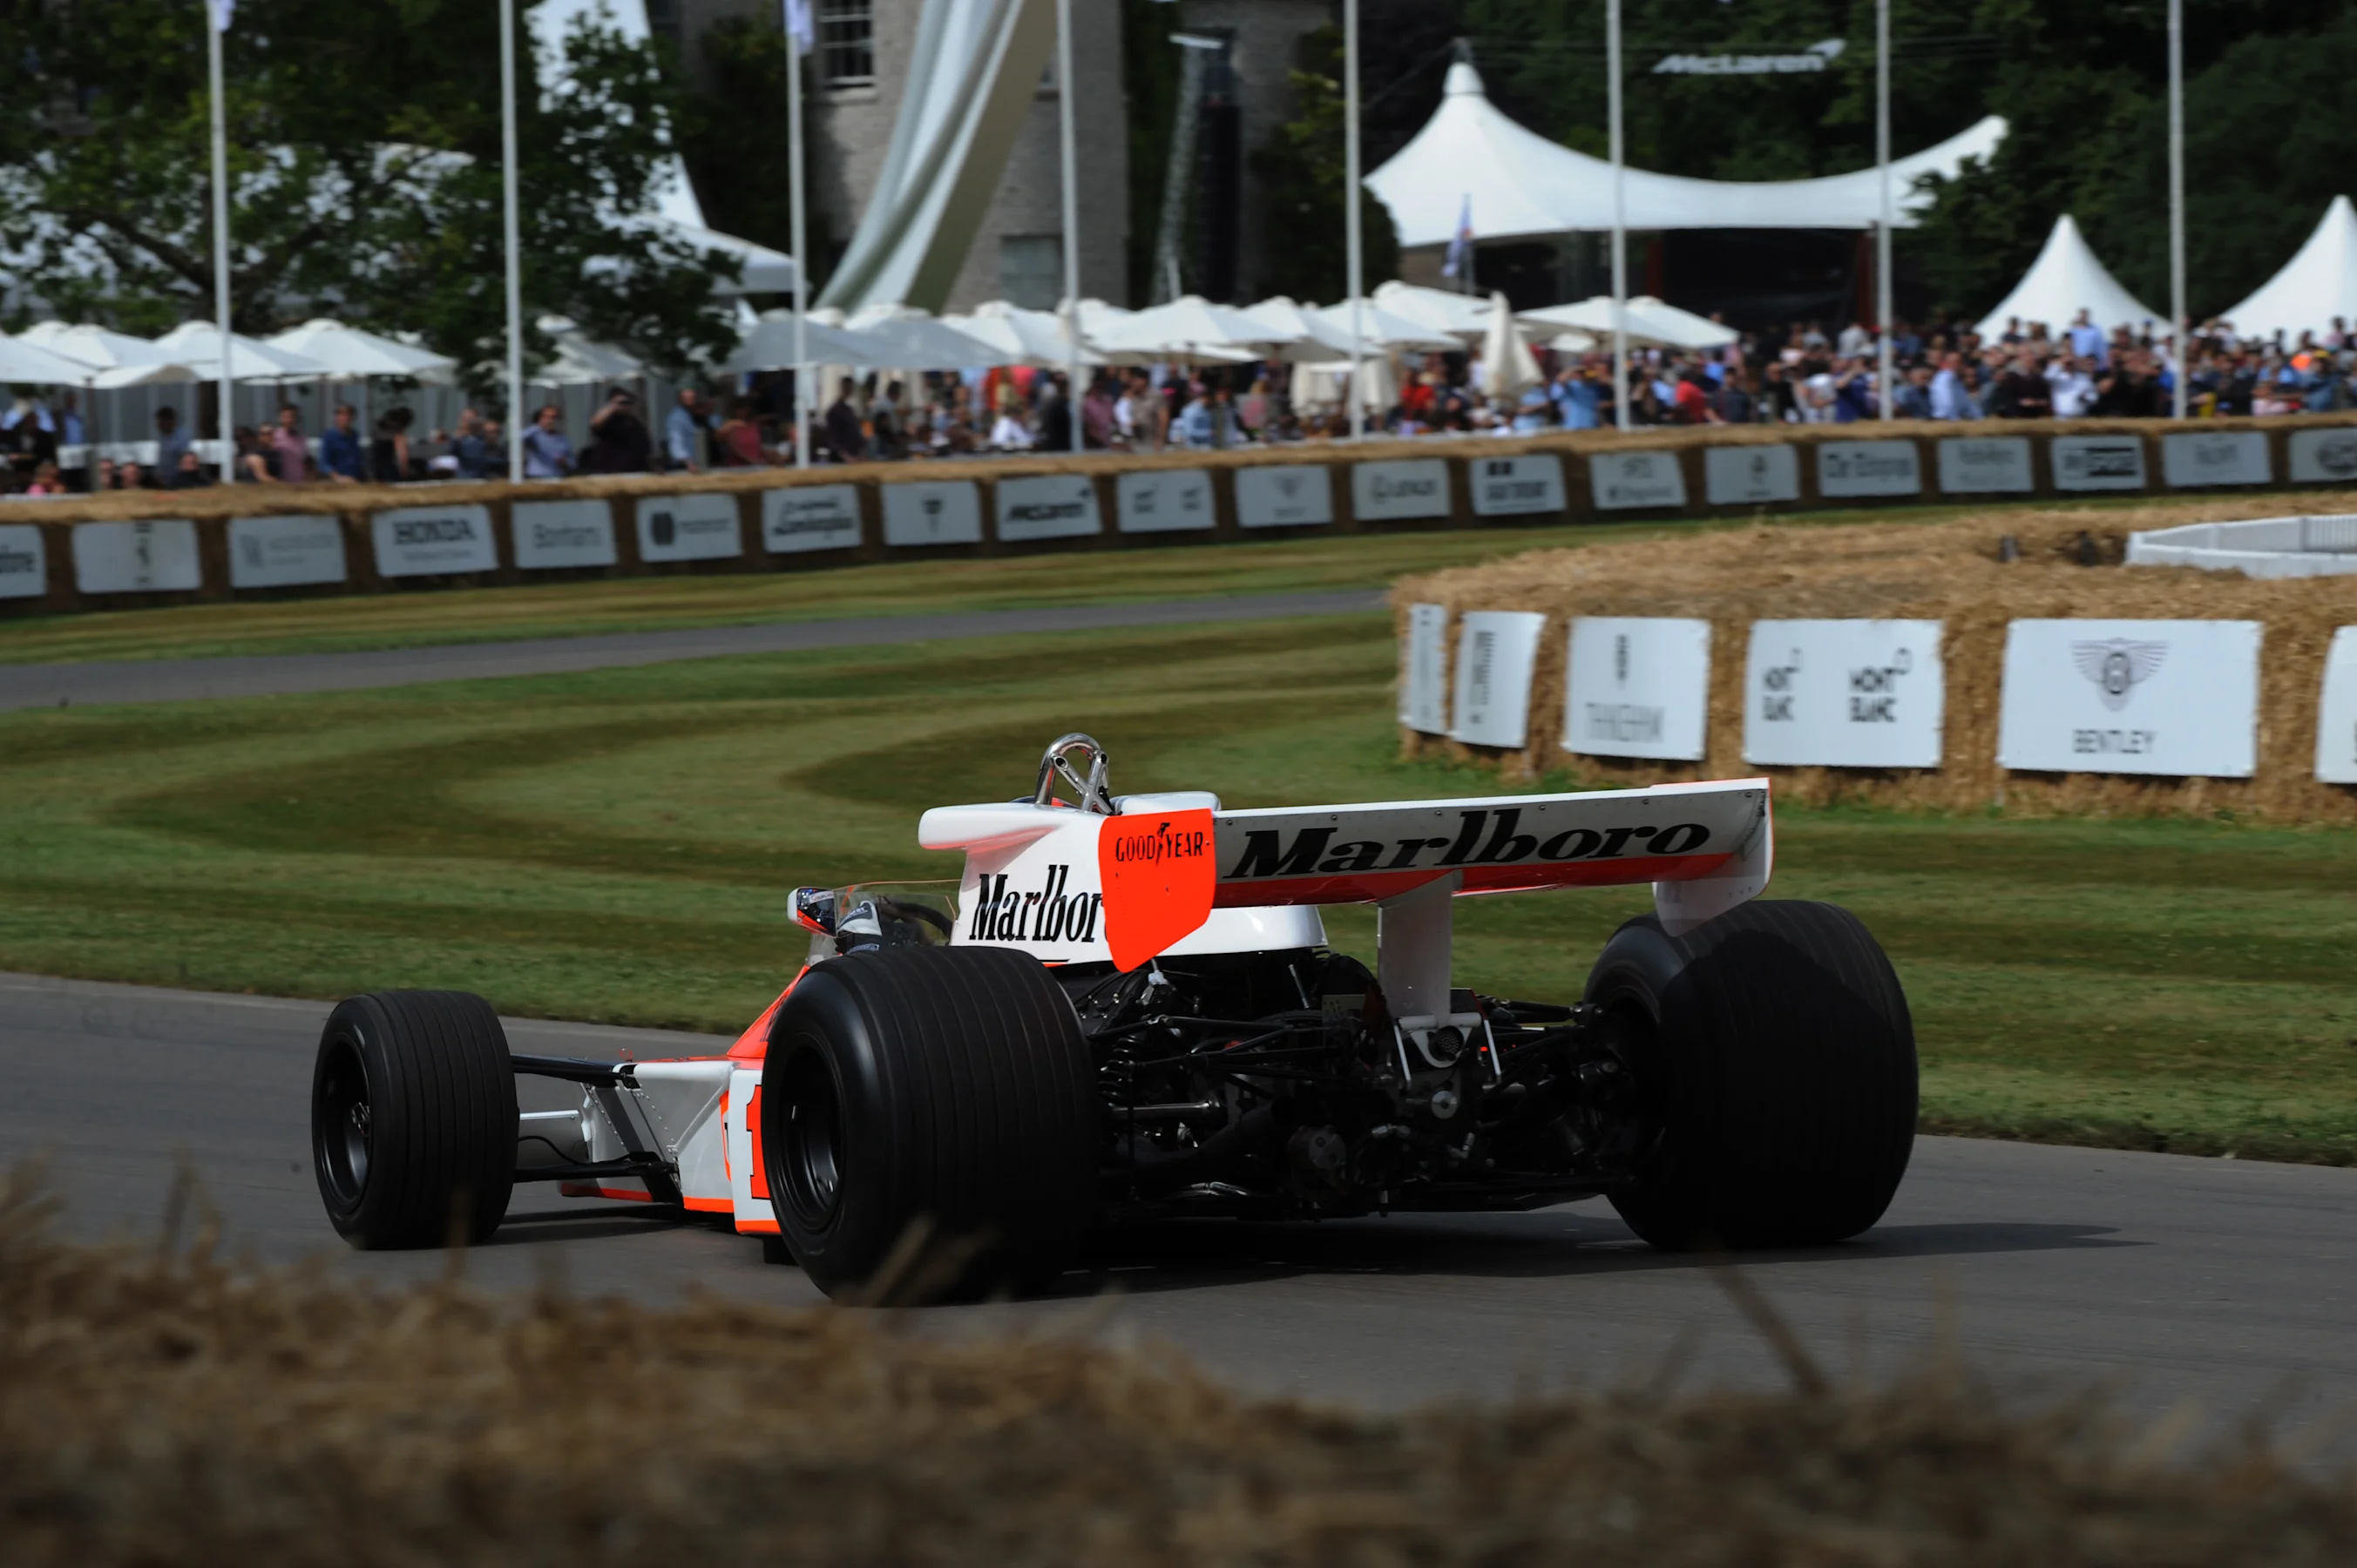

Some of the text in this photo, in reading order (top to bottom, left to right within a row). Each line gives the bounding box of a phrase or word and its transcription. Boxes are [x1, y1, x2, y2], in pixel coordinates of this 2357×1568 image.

[1652, 54, 1825, 74] McLaren
[2073, 729, 2157, 754] BENTLEY
[1222, 808, 1710, 880] Marlboro
[969, 864, 1108, 943] Marlbor
